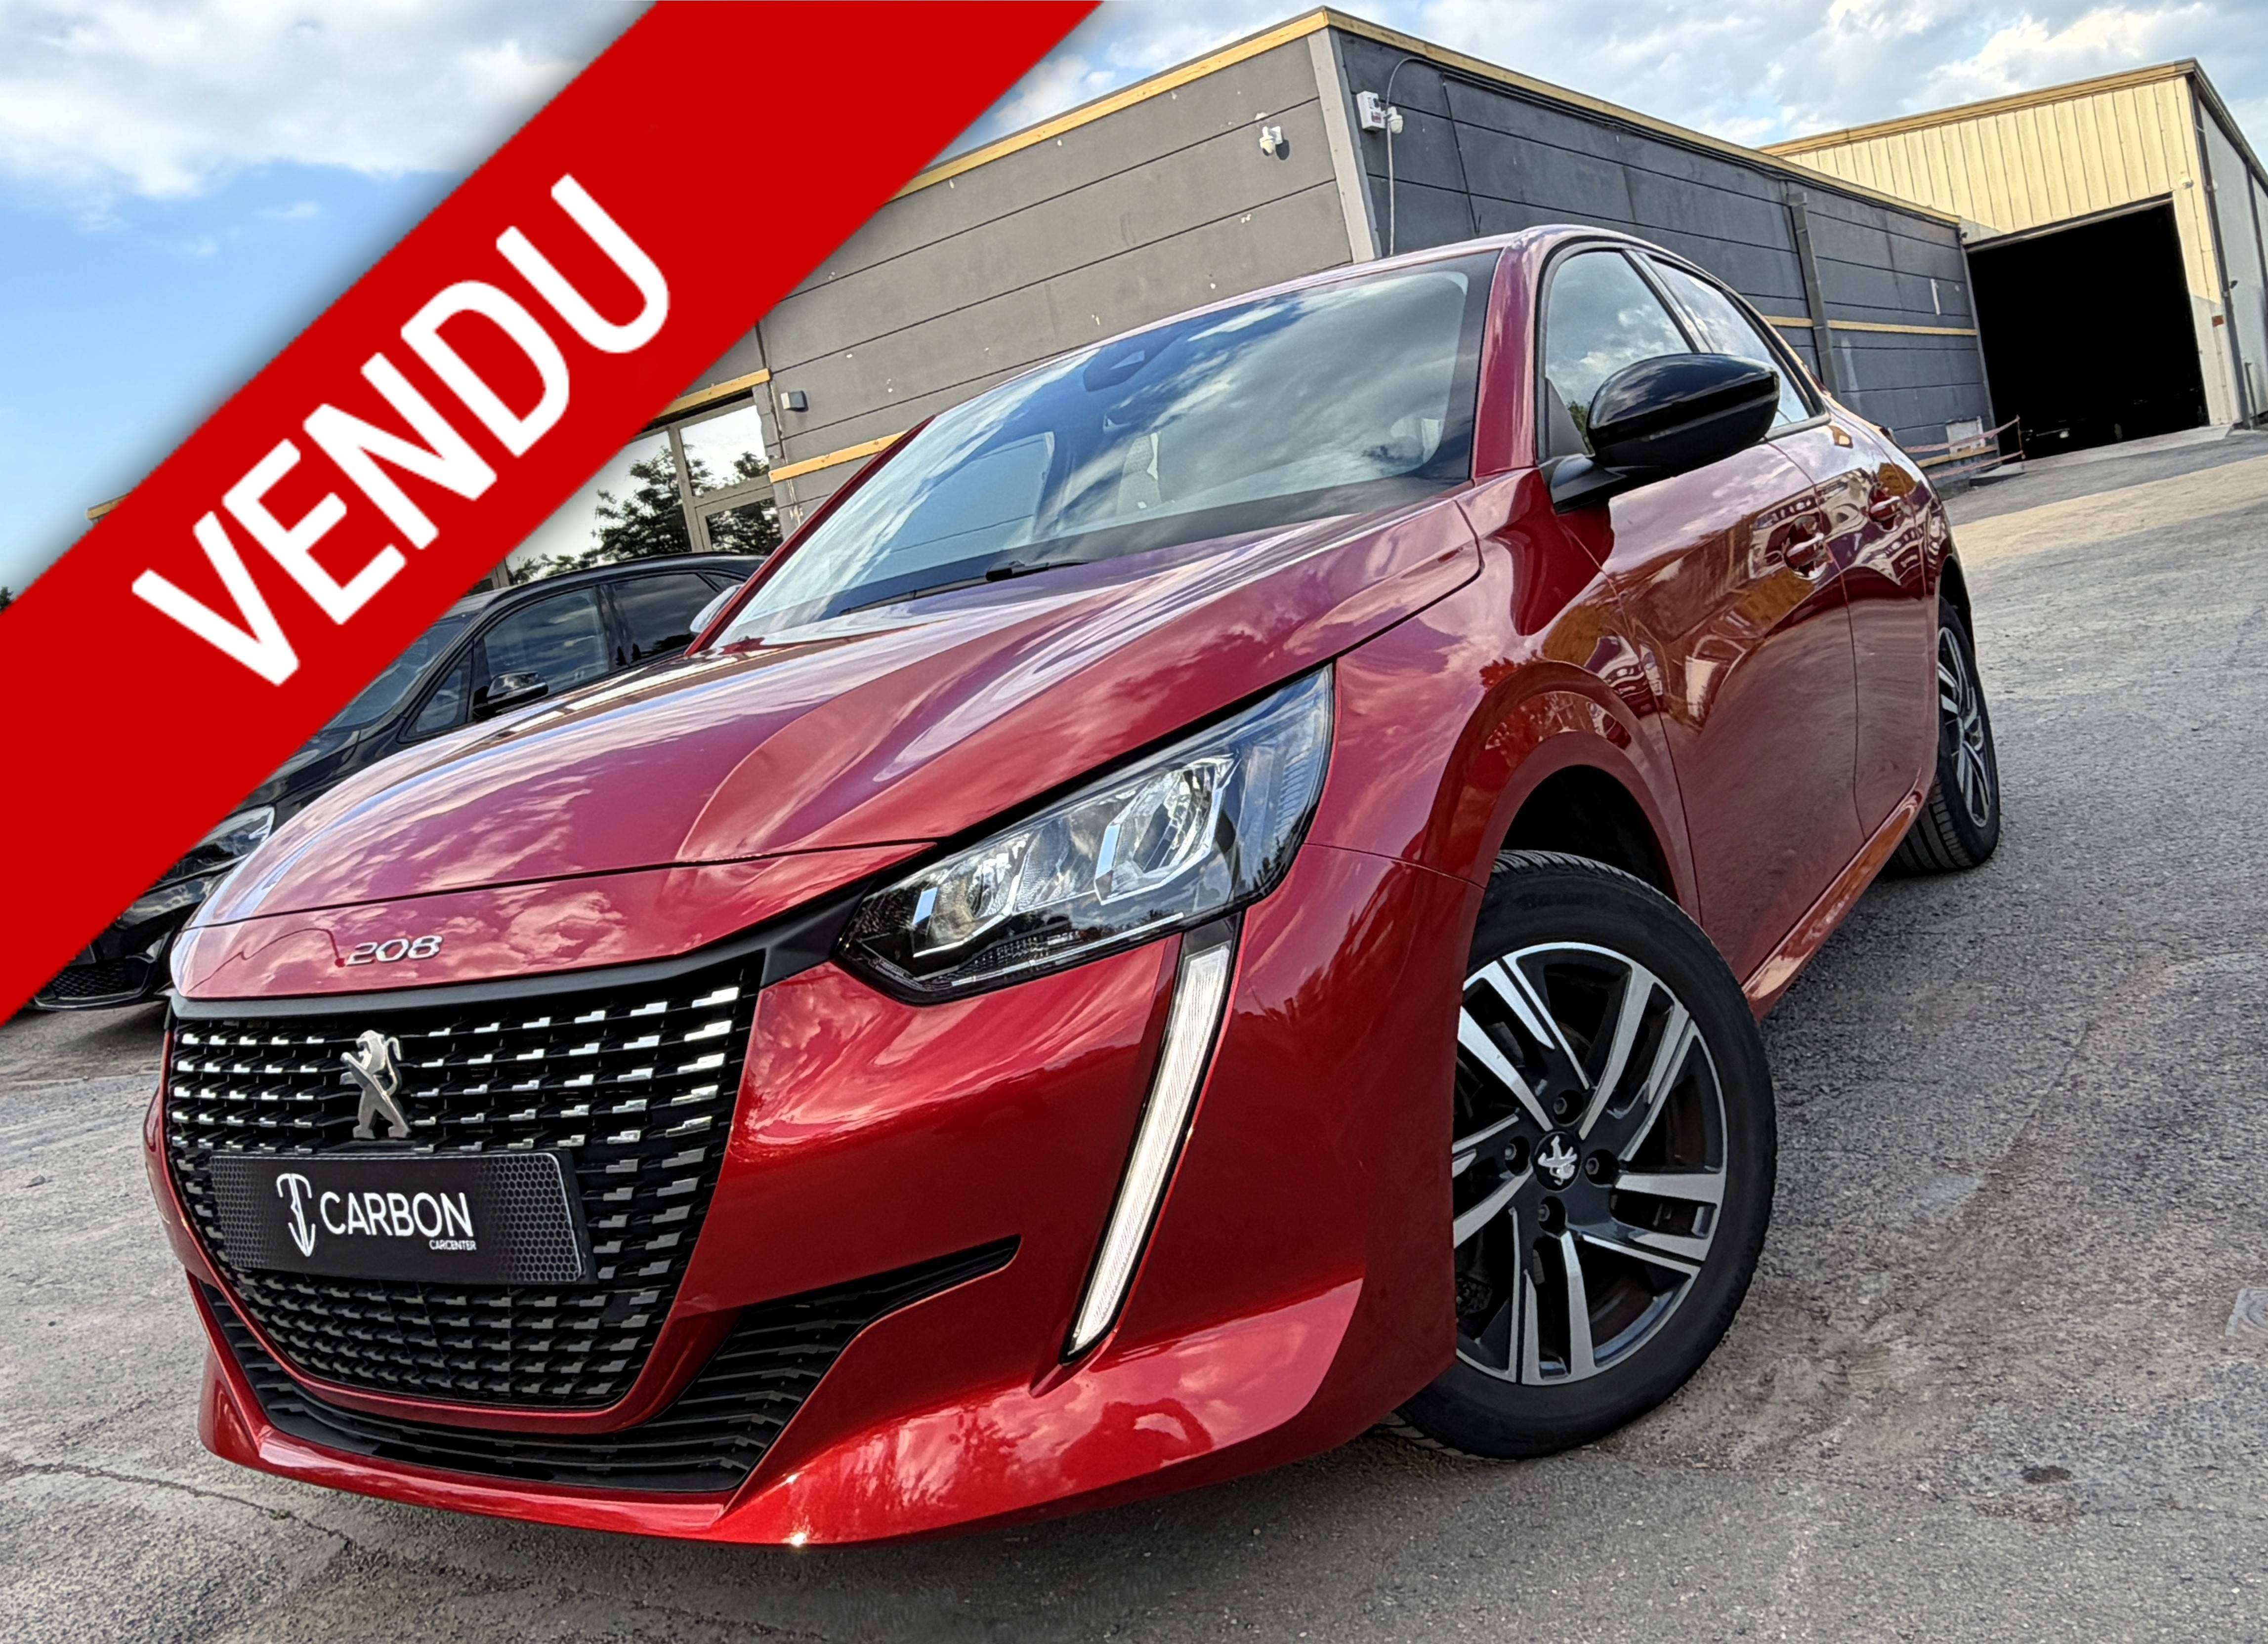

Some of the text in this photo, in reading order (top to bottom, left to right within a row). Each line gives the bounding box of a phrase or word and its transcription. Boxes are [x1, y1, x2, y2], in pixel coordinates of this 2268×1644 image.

[346, 936, 443, 966] 208
[320, 1191, 474, 1237] CARBON
[429, 1239, 477, 1250] CARCENTER
